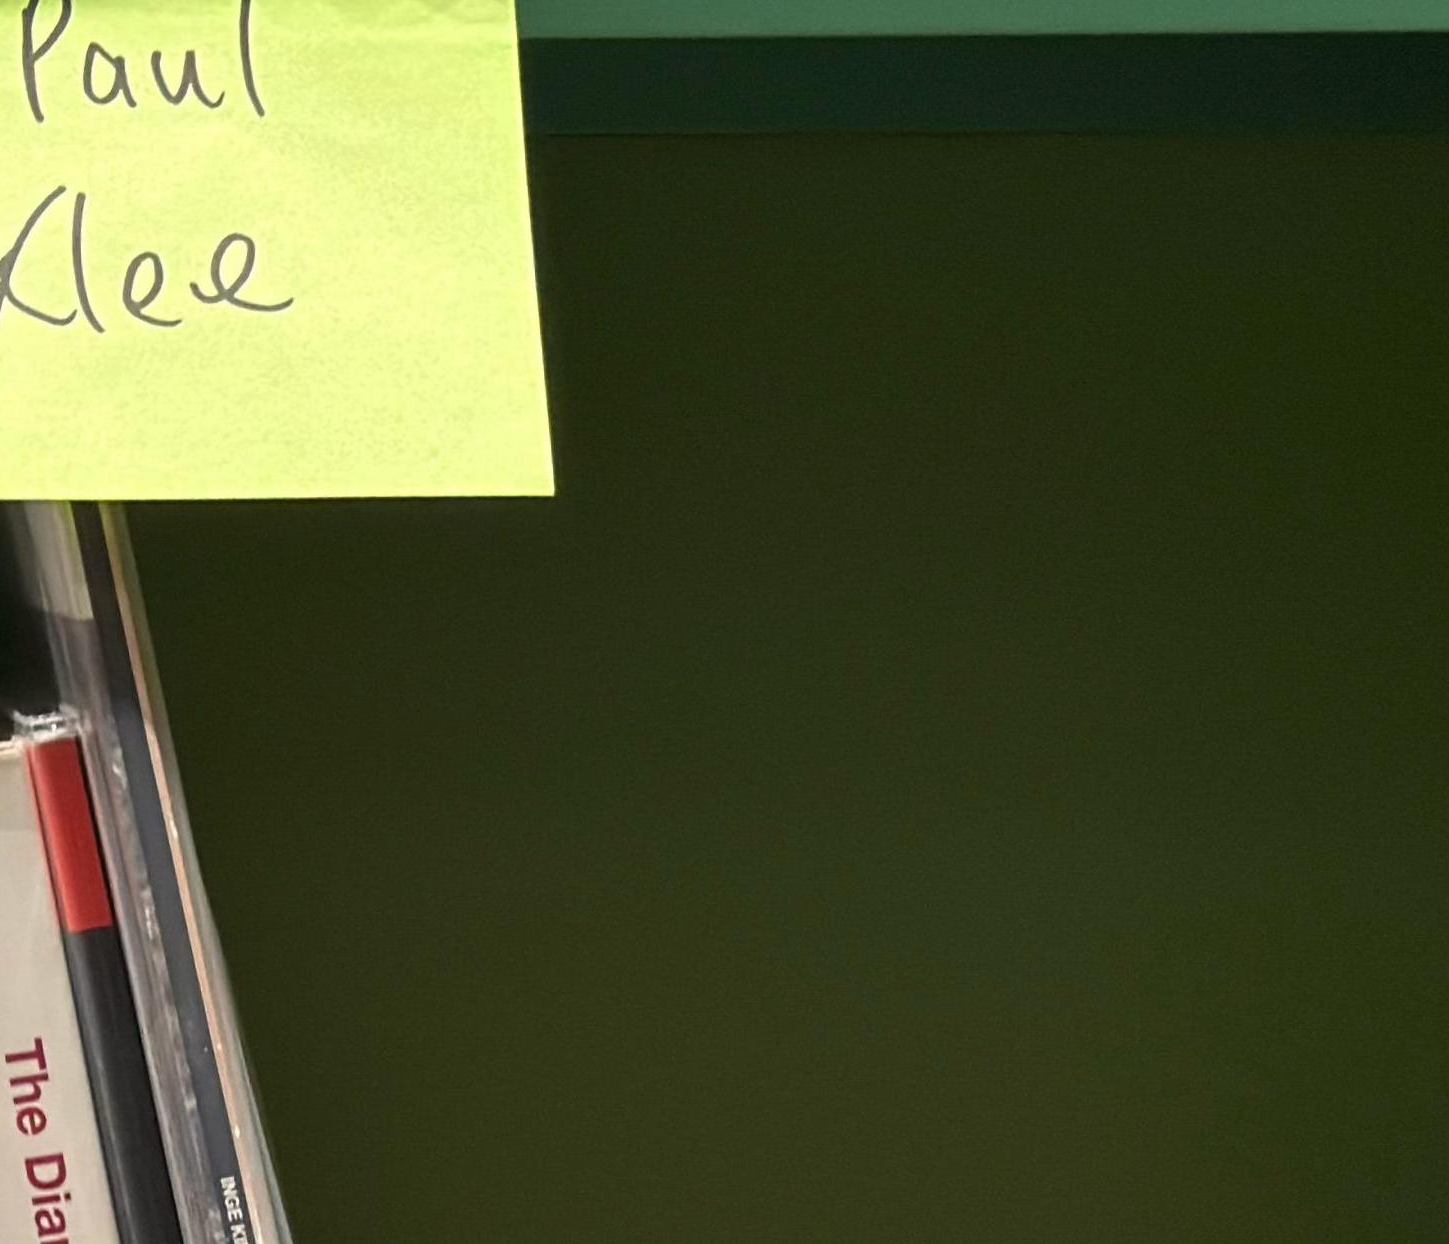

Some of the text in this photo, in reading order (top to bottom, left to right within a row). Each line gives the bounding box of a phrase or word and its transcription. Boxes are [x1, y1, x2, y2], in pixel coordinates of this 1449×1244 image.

[21, 0, 265, 122] Paul
[3, 1036, 51, 1137] The
[219, 1174, 245, 1223] INGE
